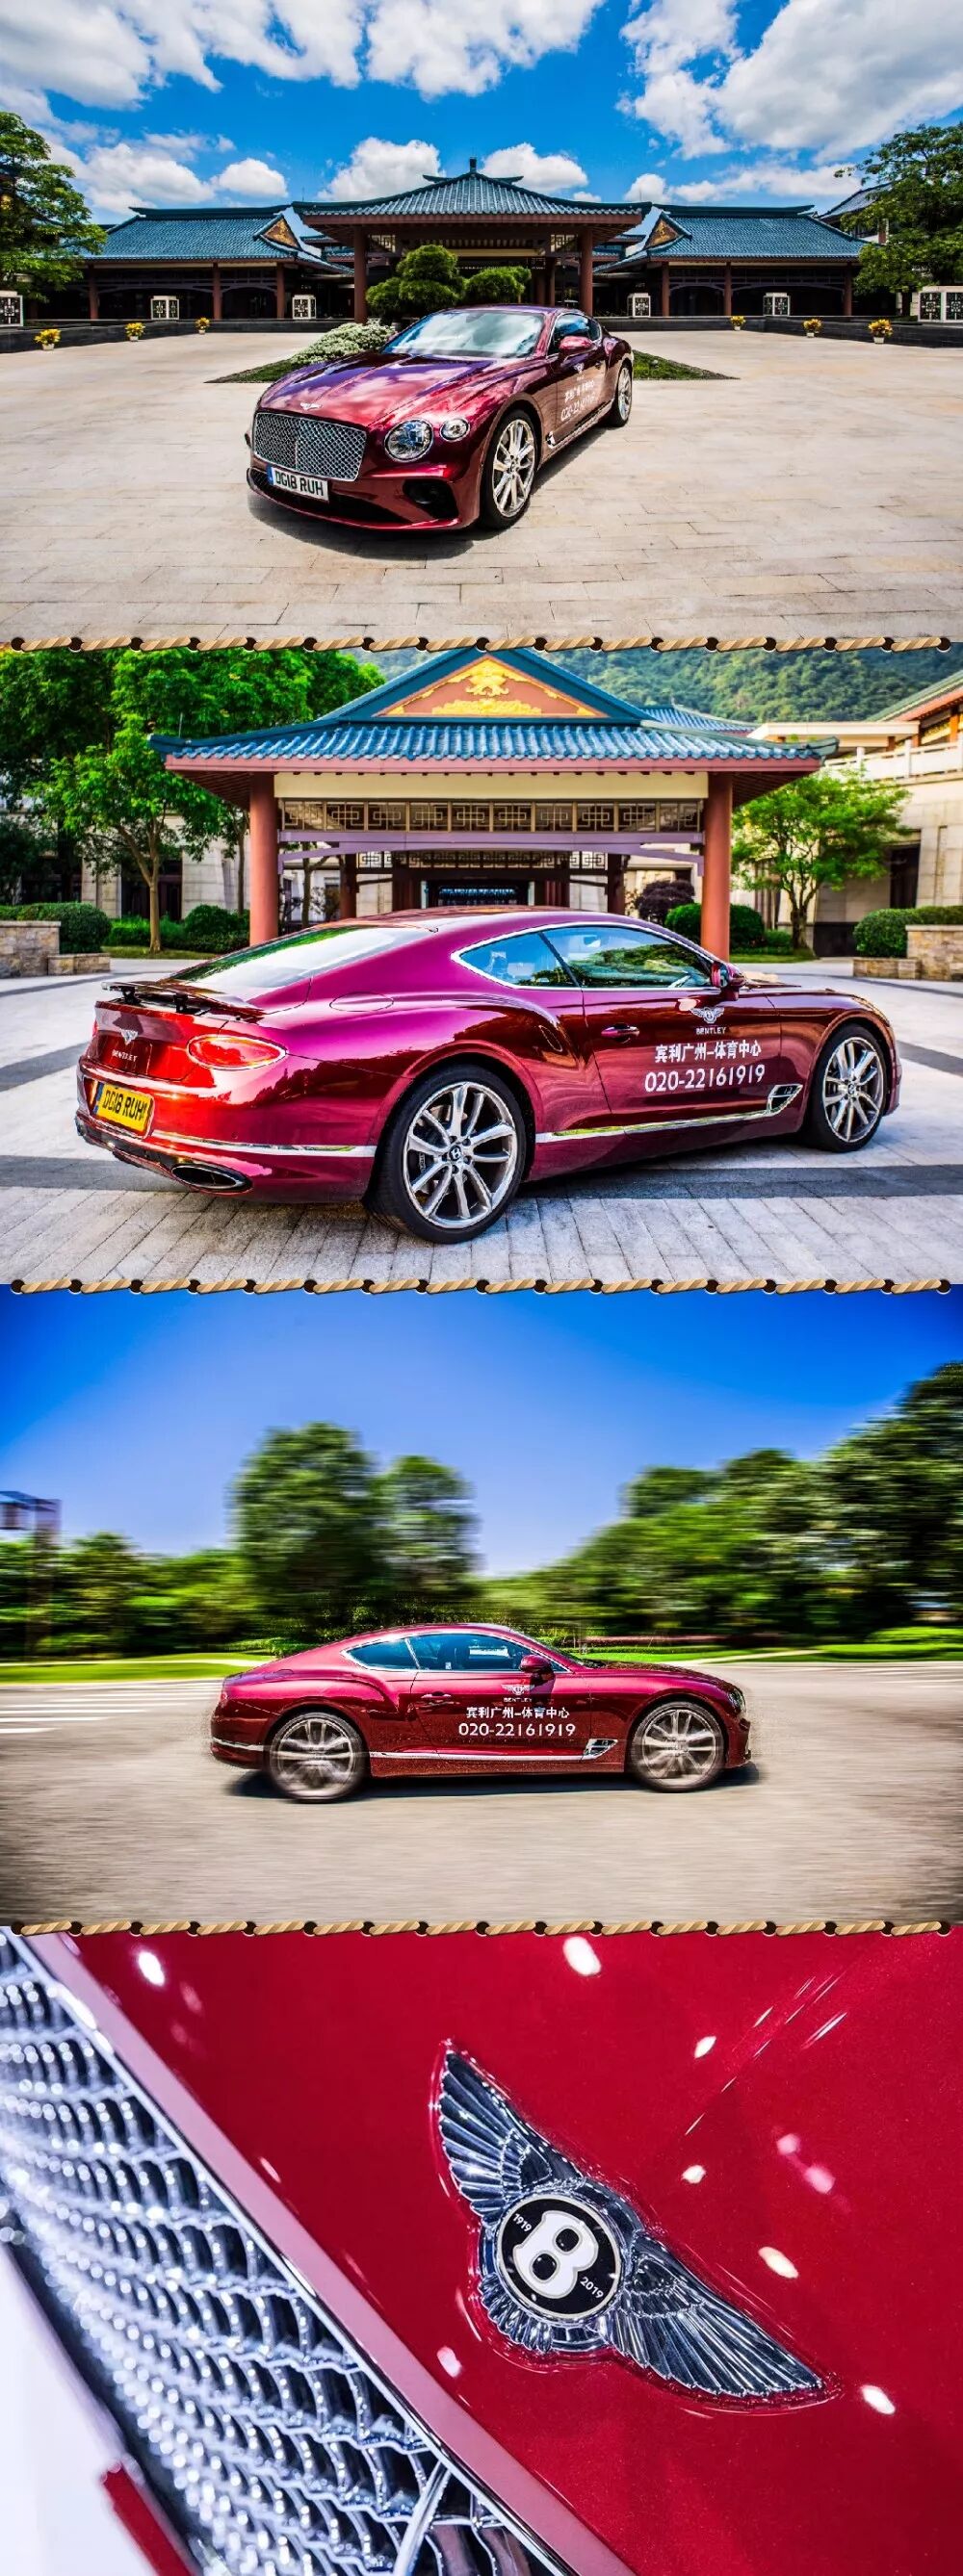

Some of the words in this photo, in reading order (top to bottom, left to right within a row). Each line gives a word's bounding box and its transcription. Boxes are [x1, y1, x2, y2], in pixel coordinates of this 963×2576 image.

[274, 470, 298, 489] DG18
[299, 477, 324, 496] RUH
[696, 1026, 726, 1035] BENTLEY
[644, 1064, 766, 1092] 020-22161919
[122, 1097, 148, 1121] RUH
[458, 1722, 576, 1737] 020-22161919
[512, 2213, 533, 2232] 1919
[512, 2210, 599, 2299] B
[580, 2276, 605, 2299] 2019
